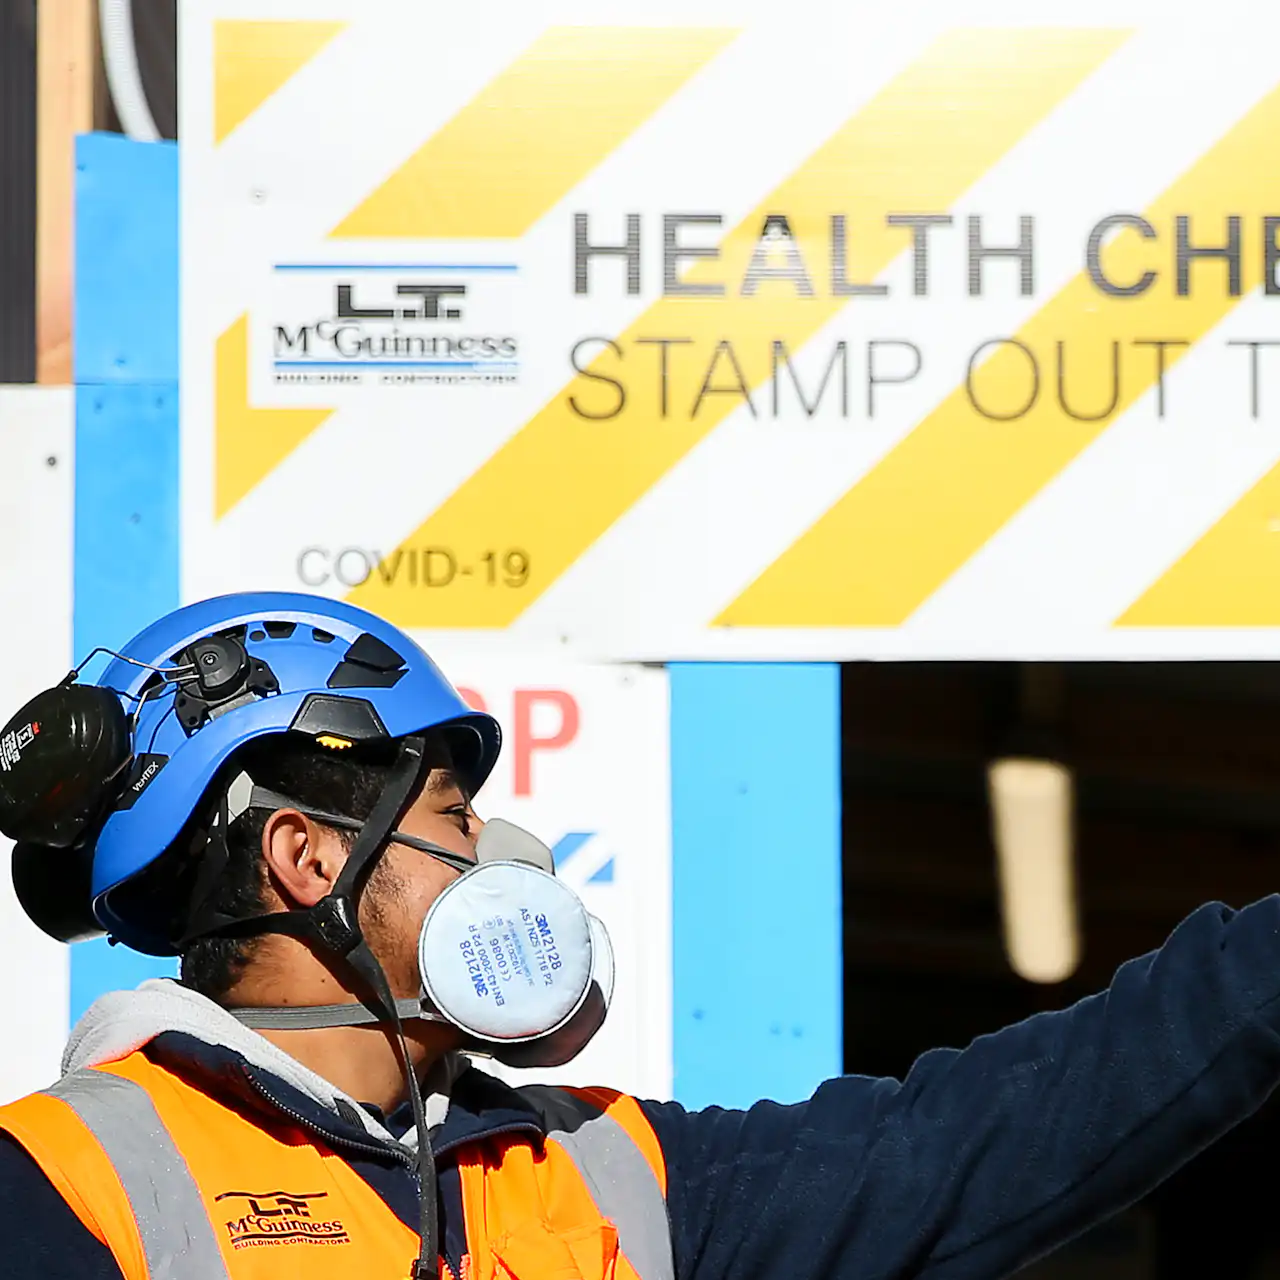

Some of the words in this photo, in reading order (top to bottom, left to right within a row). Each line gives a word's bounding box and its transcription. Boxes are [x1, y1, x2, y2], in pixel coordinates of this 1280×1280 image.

[573, 213, 1035, 297] HEALTH
[338, 284, 466, 318] L.T.
[274, 320, 517, 358] McGuinness
[566, 337, 923, 421] STAMP
[965, 338, 1190, 422] OUT
[296, 547, 531, 589] COVID-19
[460, 940, 480, 974] 2128
[542, 936, 562, 970] 2128
[226, 1214, 343, 1237] McGuinness
[234, 1239, 281, 1251] BUILDING
[283, 1237, 351, 1247] CONTRACTORS
